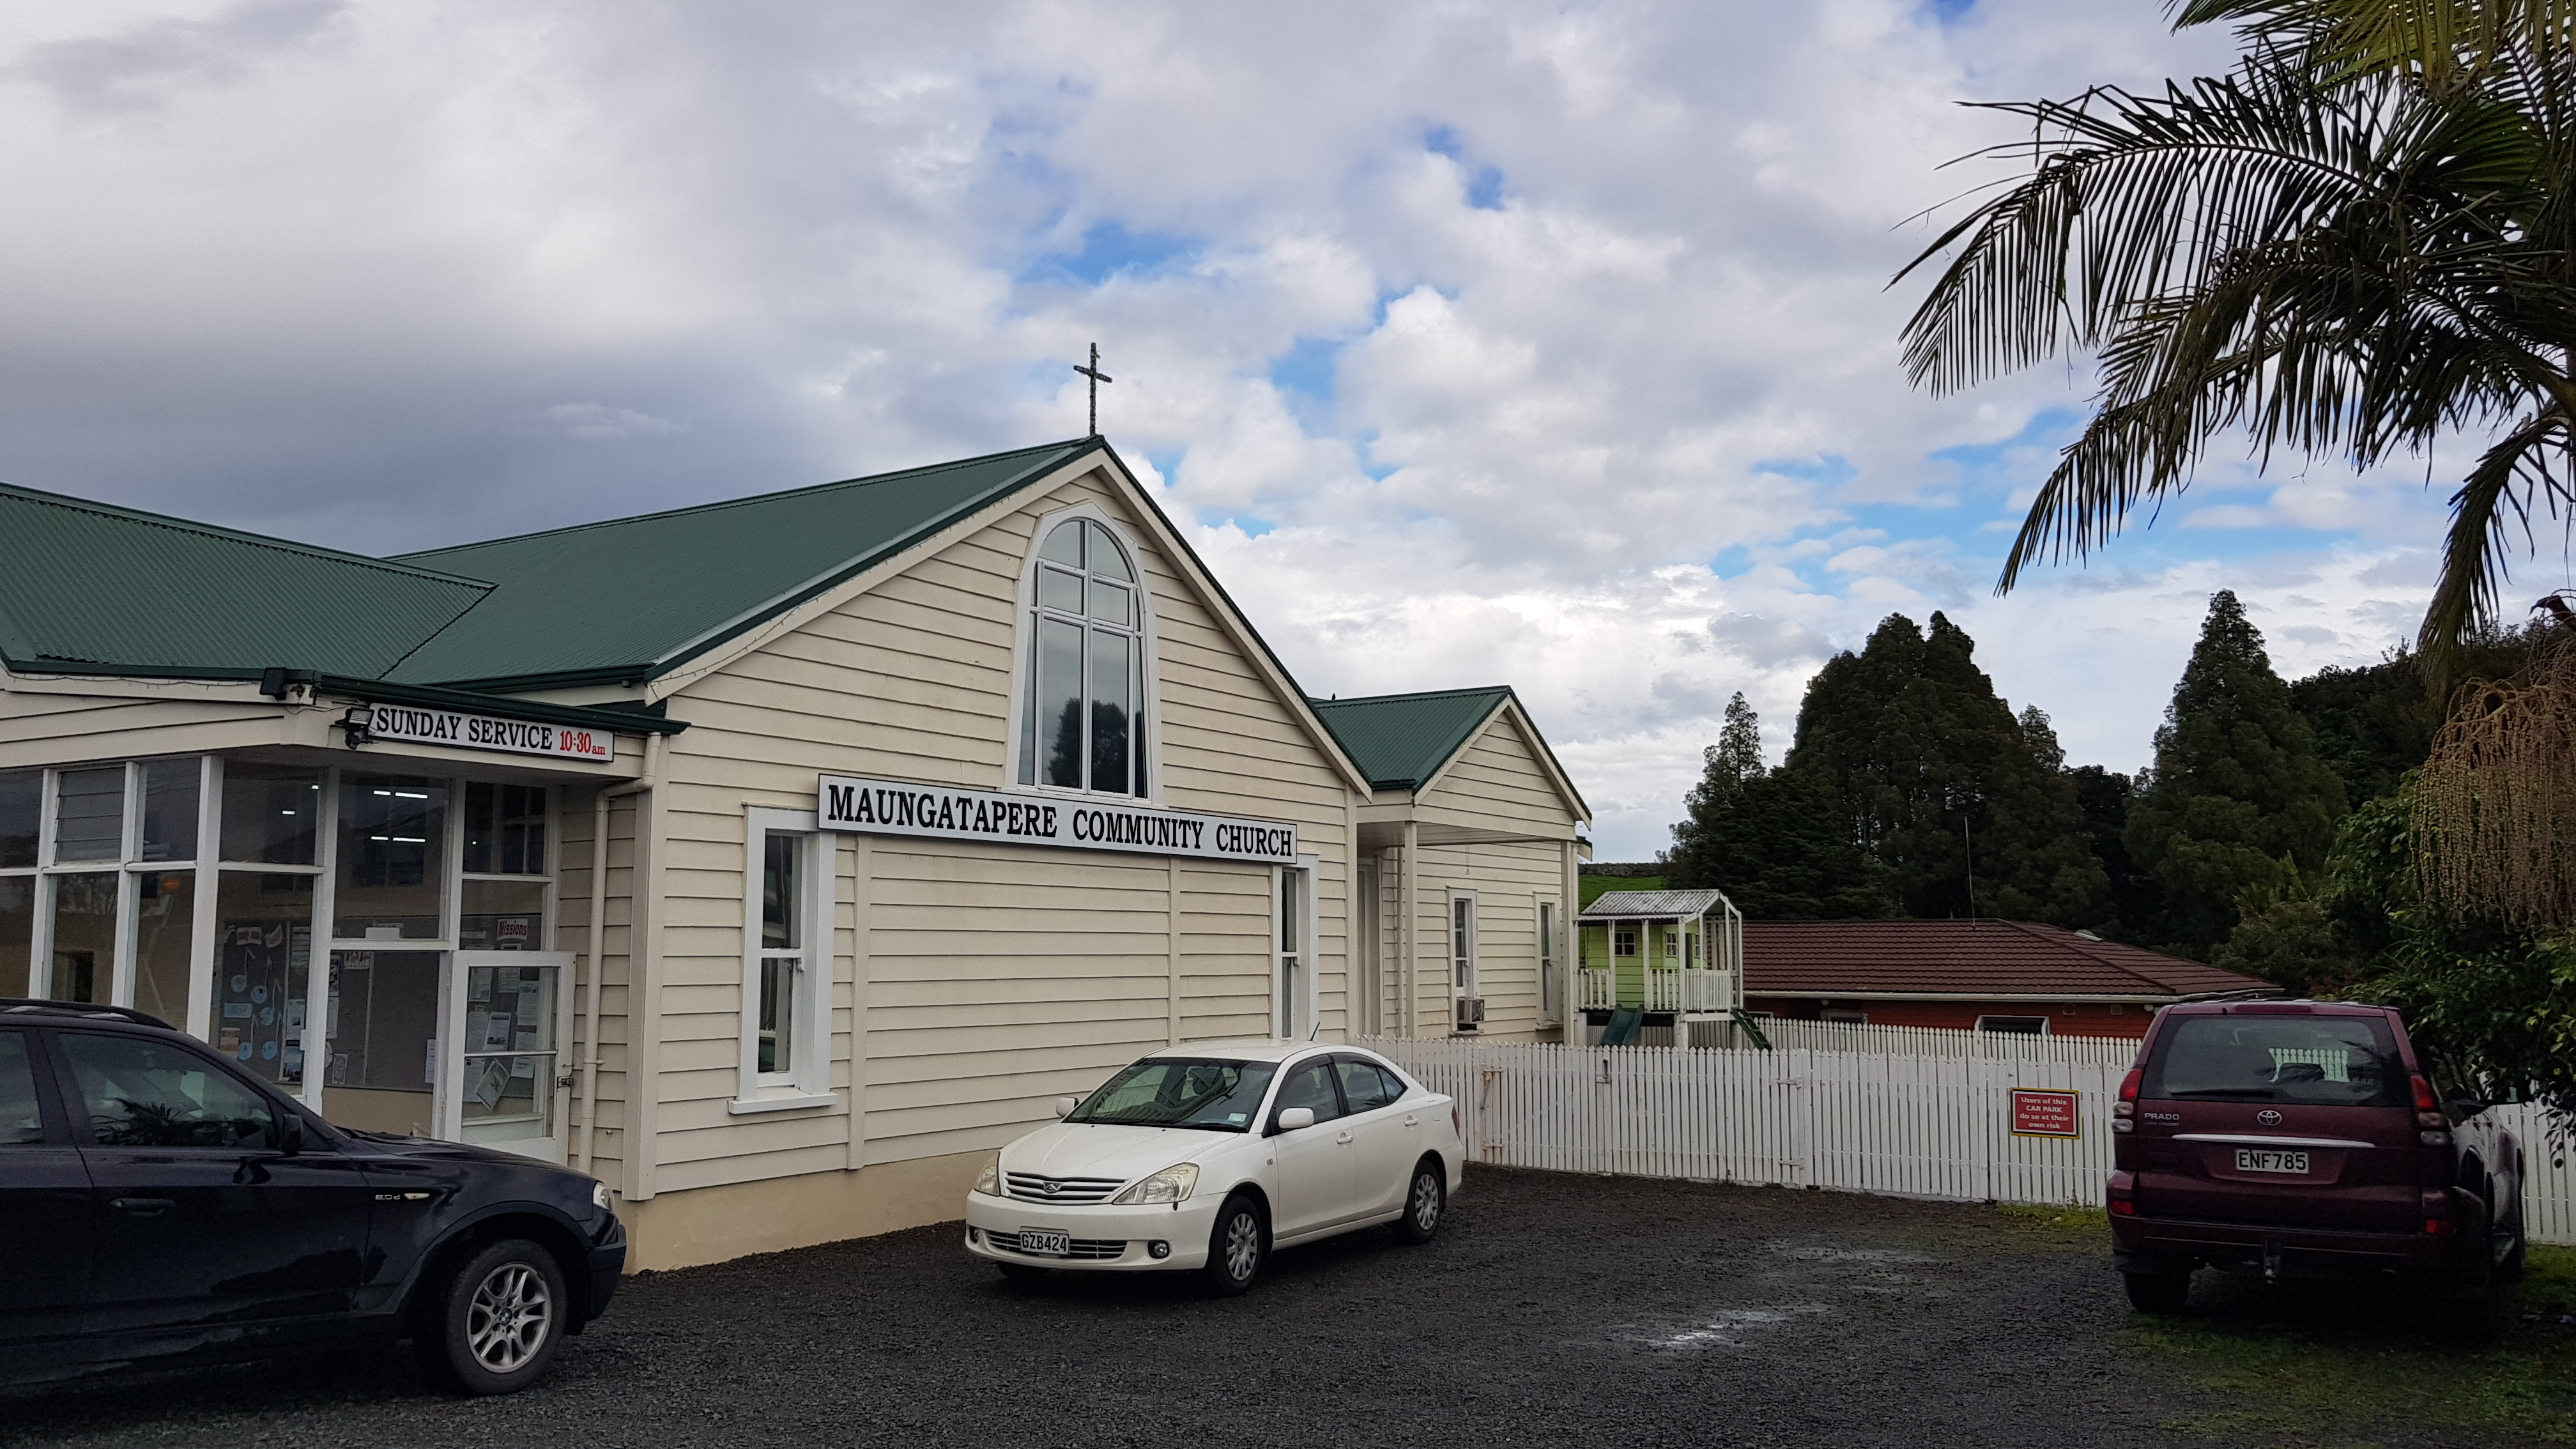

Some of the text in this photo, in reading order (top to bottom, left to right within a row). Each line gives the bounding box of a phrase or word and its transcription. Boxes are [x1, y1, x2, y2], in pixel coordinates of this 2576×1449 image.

[376, 707, 606, 755] SUNDAY SERVICE 10:30 am
[828, 785, 1292, 857] MAUNGATAPERE COMMUNITY CHURCH
[499, 920, 527, 936] Missions
[2144, 1112, 2179, 1121] PRADO
[2239, 1152, 2306, 1170] ENF785
[1022, 1234, 1067, 1252] GZB424
